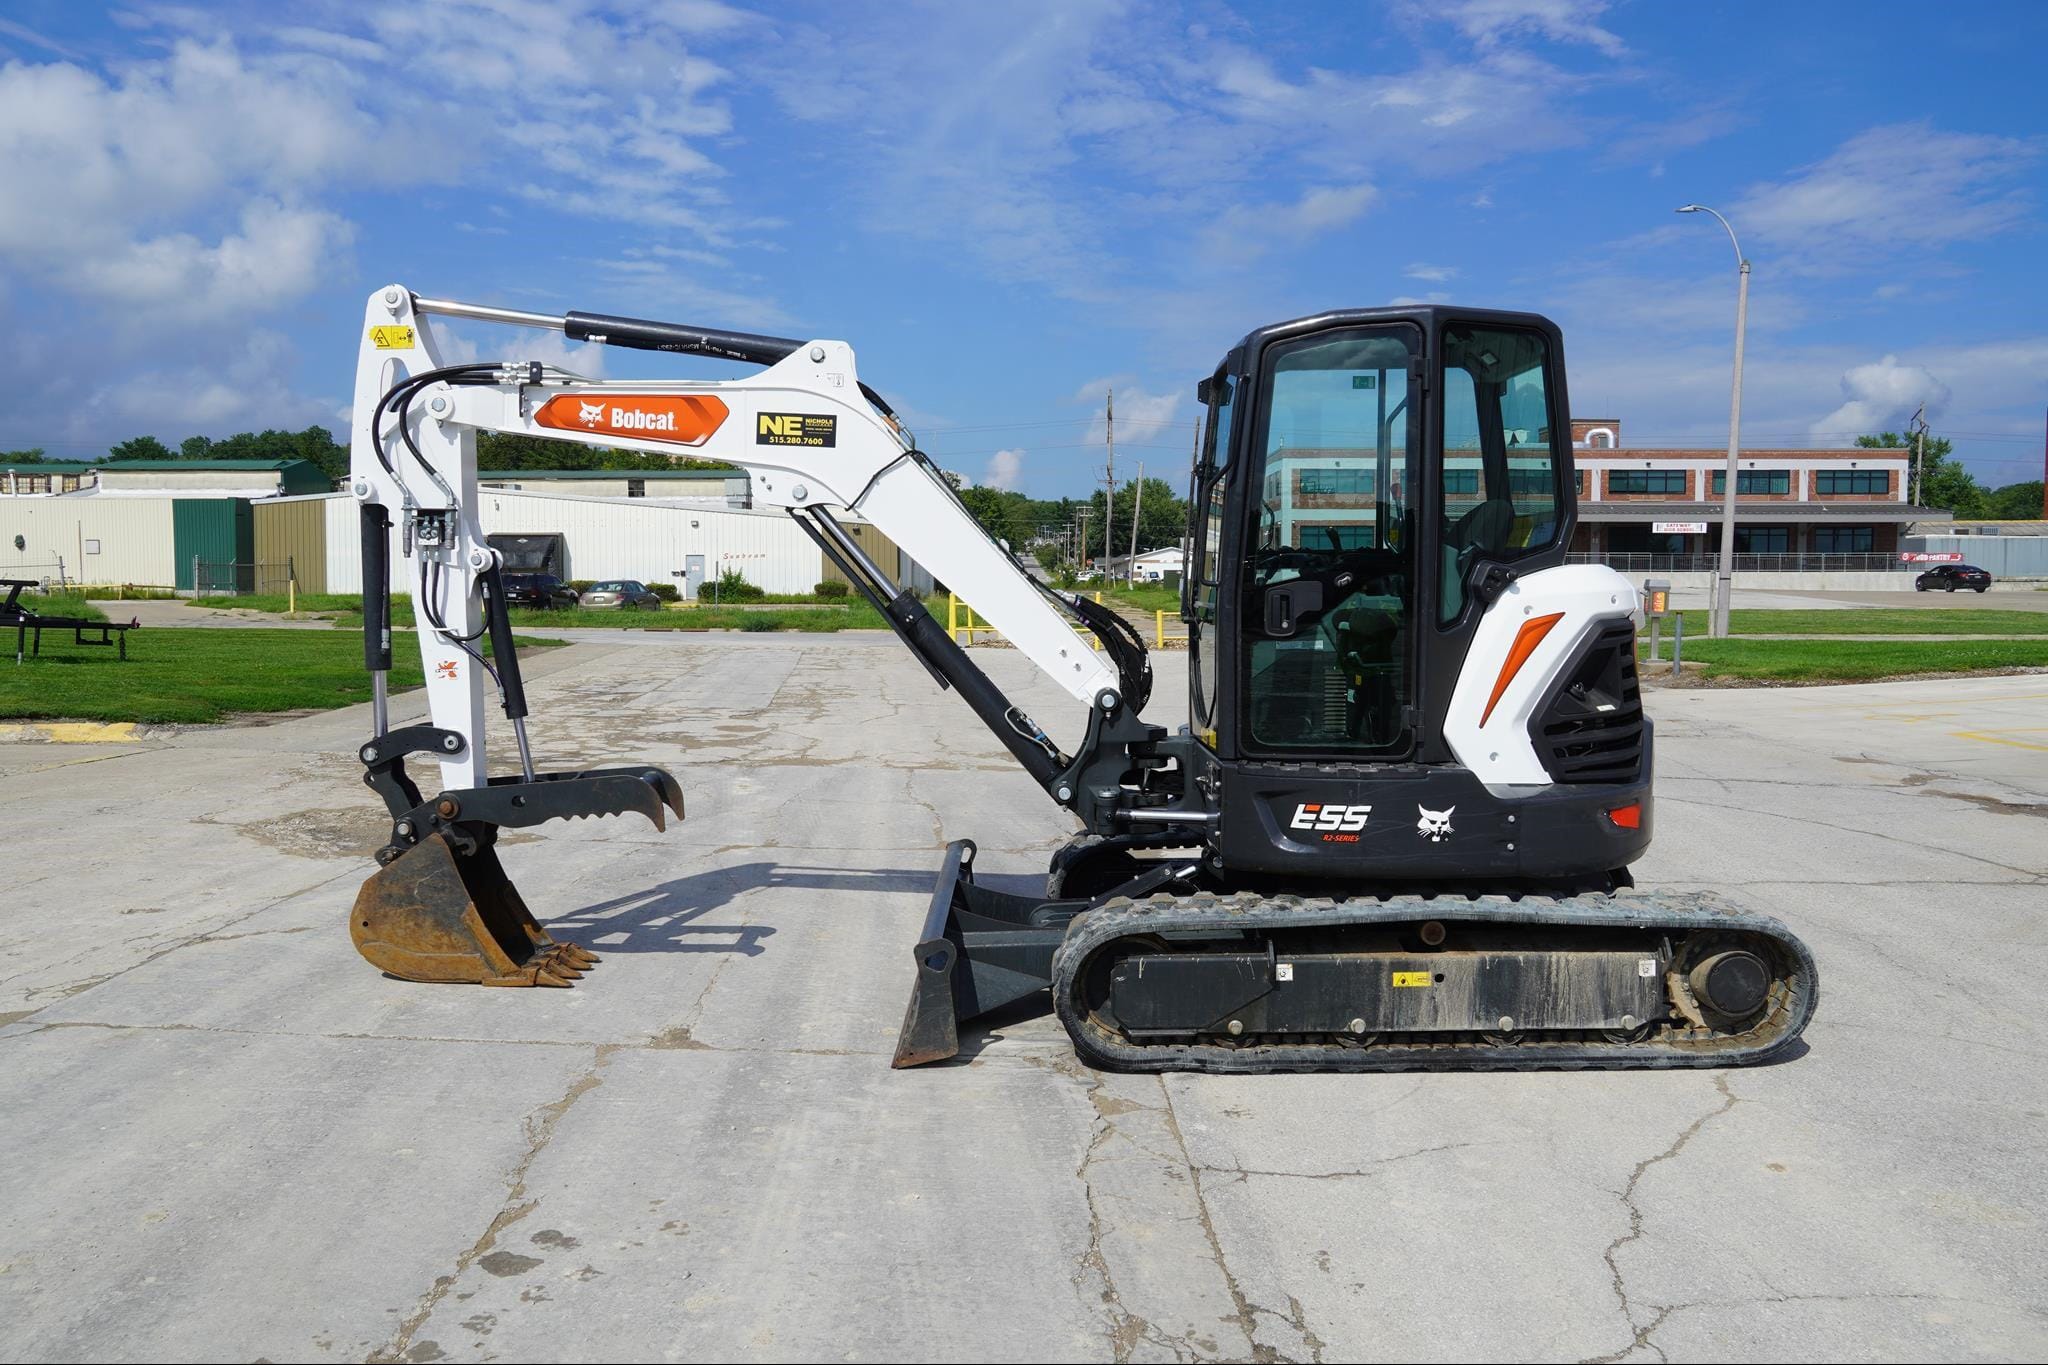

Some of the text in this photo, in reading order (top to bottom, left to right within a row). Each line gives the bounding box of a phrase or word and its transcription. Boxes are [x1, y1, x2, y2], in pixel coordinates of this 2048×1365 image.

[611, 408, 674, 430] Bobcat
[760, 415, 803, 436] NE
[769, 436, 823, 445] 515.280.7600
[1290, 804, 1372, 831] E55
[1322, 834, 1360, 843] R2-SERIES
